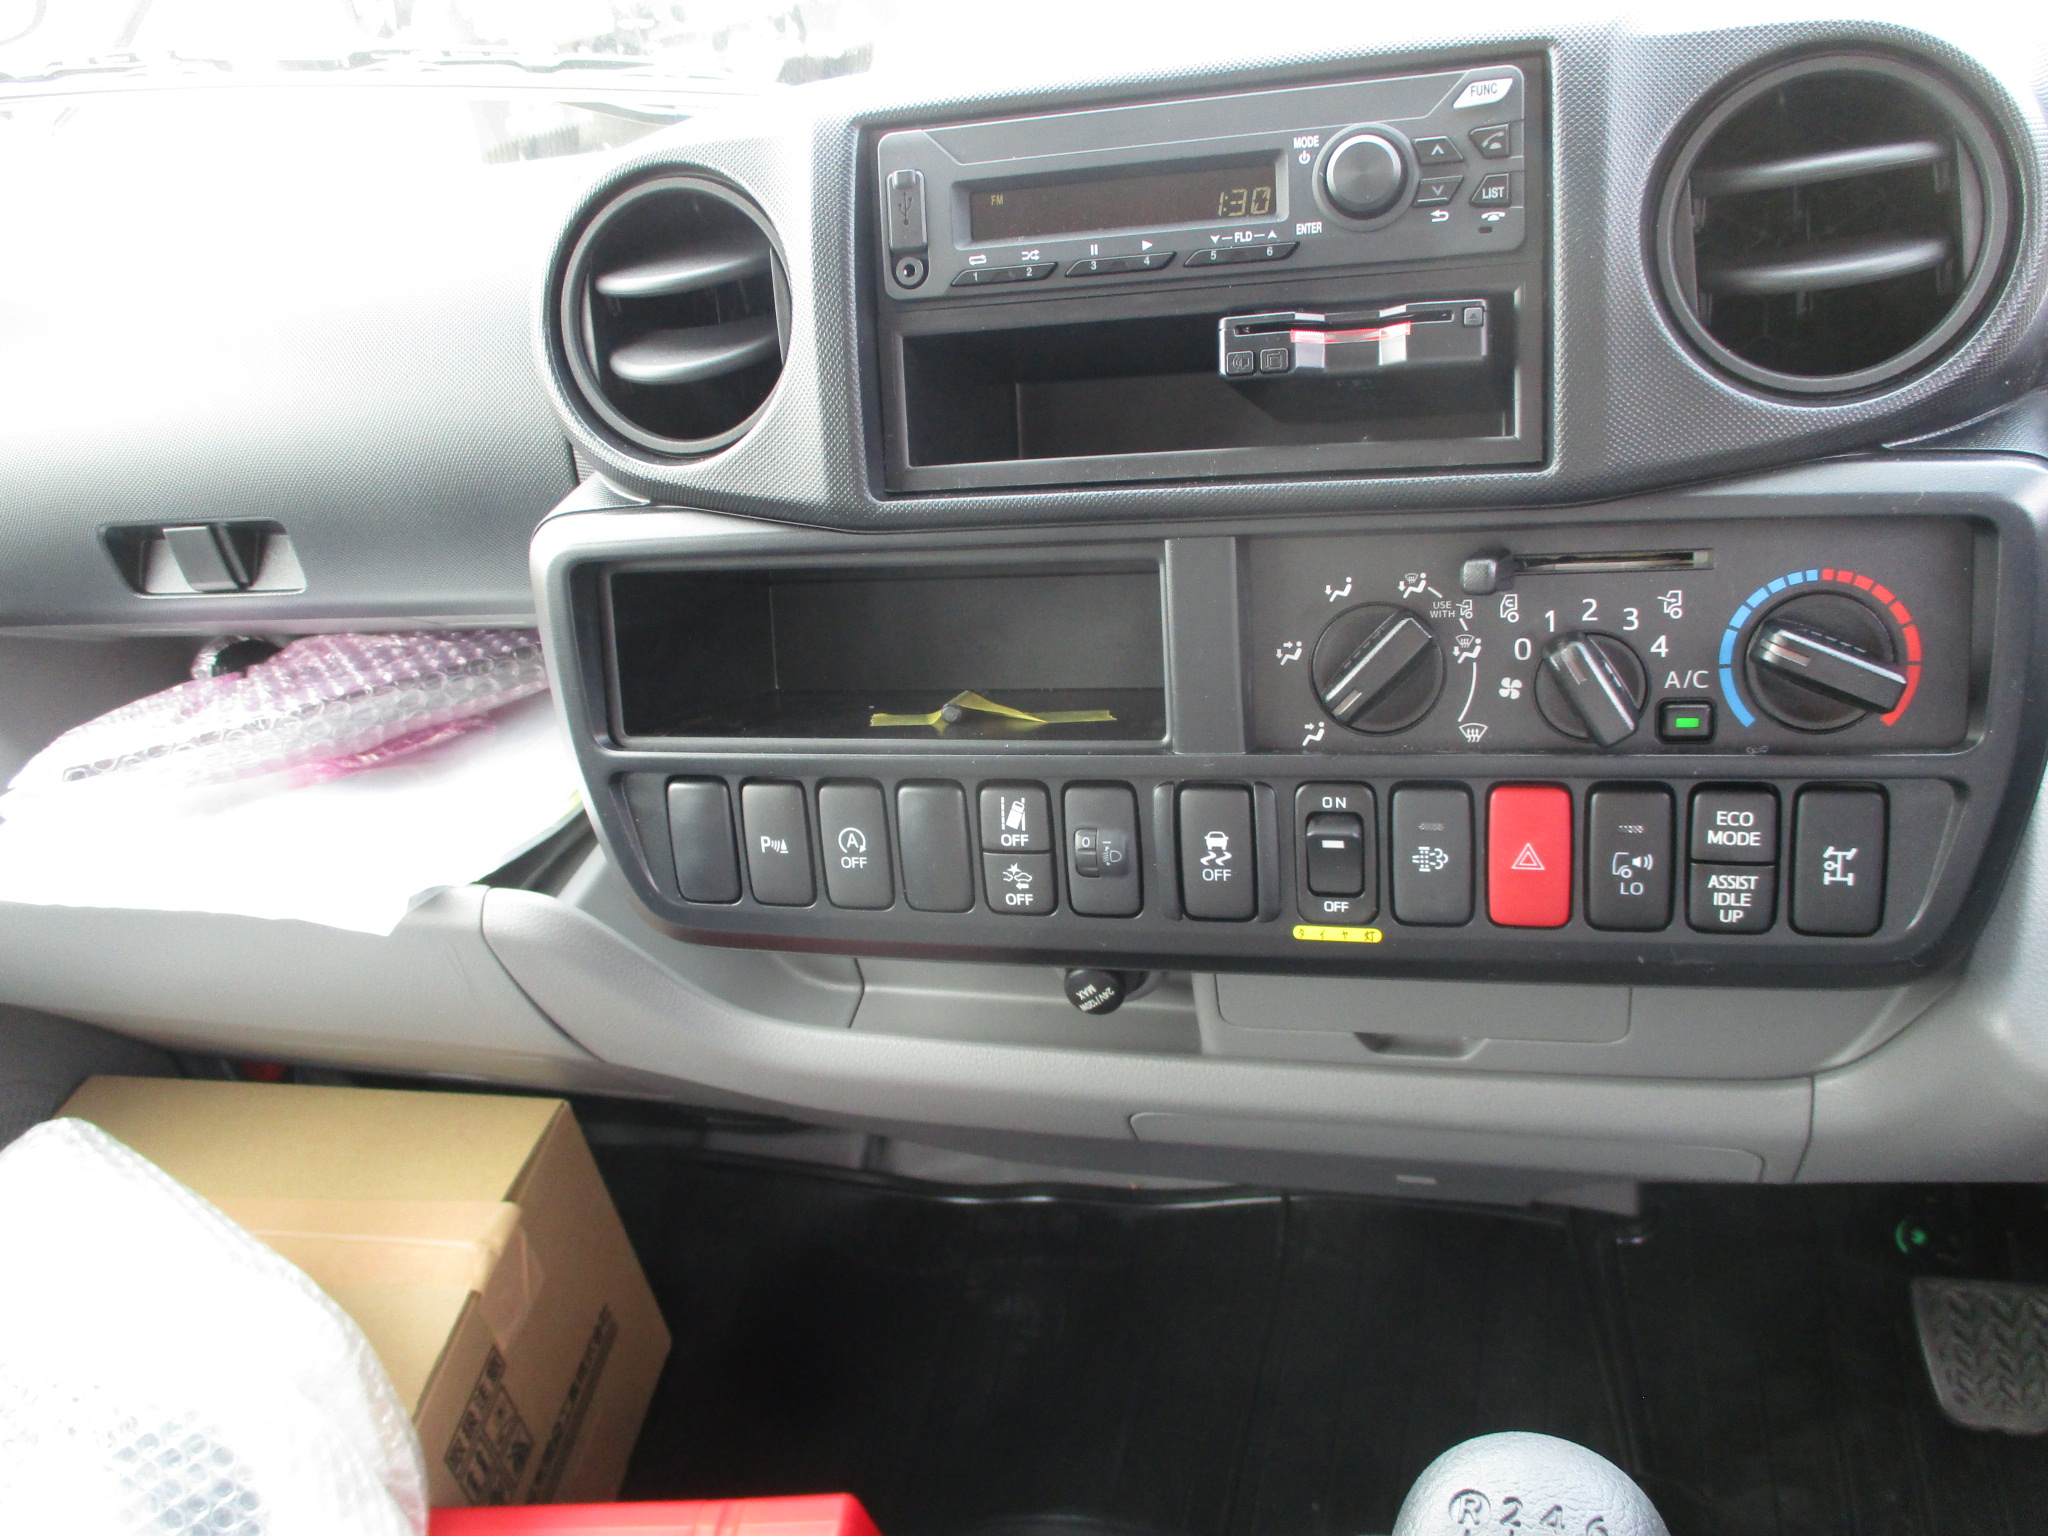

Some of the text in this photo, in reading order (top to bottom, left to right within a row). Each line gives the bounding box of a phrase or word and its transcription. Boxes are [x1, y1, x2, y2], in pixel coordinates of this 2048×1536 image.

[1469, 82, 1498, 97] FUNC
[1293, 135, 1320, 149] MODE
[990, 194, 1004, 206] FM
[1481, 186, 1505, 200] LIST
[1216, 187, 1271, 218] 1:30
[1295, 221, 1322, 235] ENTER
[1234, 231, 1253, 243] FLD
[1209, 249, 1217, 261] 5
[1265, 246, 1273, 257] 6
[1090, 260, 1098, 271] 3
[1143, 255, 1150, 266] 4
[972, 271, 979, 283] 1
[1025, 266, 1033, 277] 2
[1432, 600, 1452, 610] USE
[1581, 599, 1598, 621] 2
[1429, 609, 1456, 619] WITH
[1544, 610, 1555, 632] 1
[1622, 608, 1639, 631] 3
[1513, 638, 1532, 660] 0
[1650, 635, 1669, 658] 4
[1663, 670, 1709, 689] A/C
[1322, 796, 1347, 809] ON
[1716, 810, 1754, 827] ECO
[846, 835, 859, 849] A
[1000, 834, 1029, 847] OFF
[1081, 837, 1090, 848] 0
[1707, 830, 1761, 846] MODE
[840, 856, 867, 869] OFF
[1202, 869, 1232, 882] OFF
[1707, 875, 1759, 890] ASSIST
[1620, 882, 1644, 896] LO
[1005, 893, 1034, 906] OFF
[1713, 892, 1752, 907] IDLE
[1323, 901, 1349, 913] OFF
[1719, 909, 1744, 923] UP
[1075, 983, 1097, 1001] MAX
[1458, 1496, 1483, 1525] R
[1500, 1496, 1524, 1528] 2
[1539, 1504, 1566, 1530] 4
